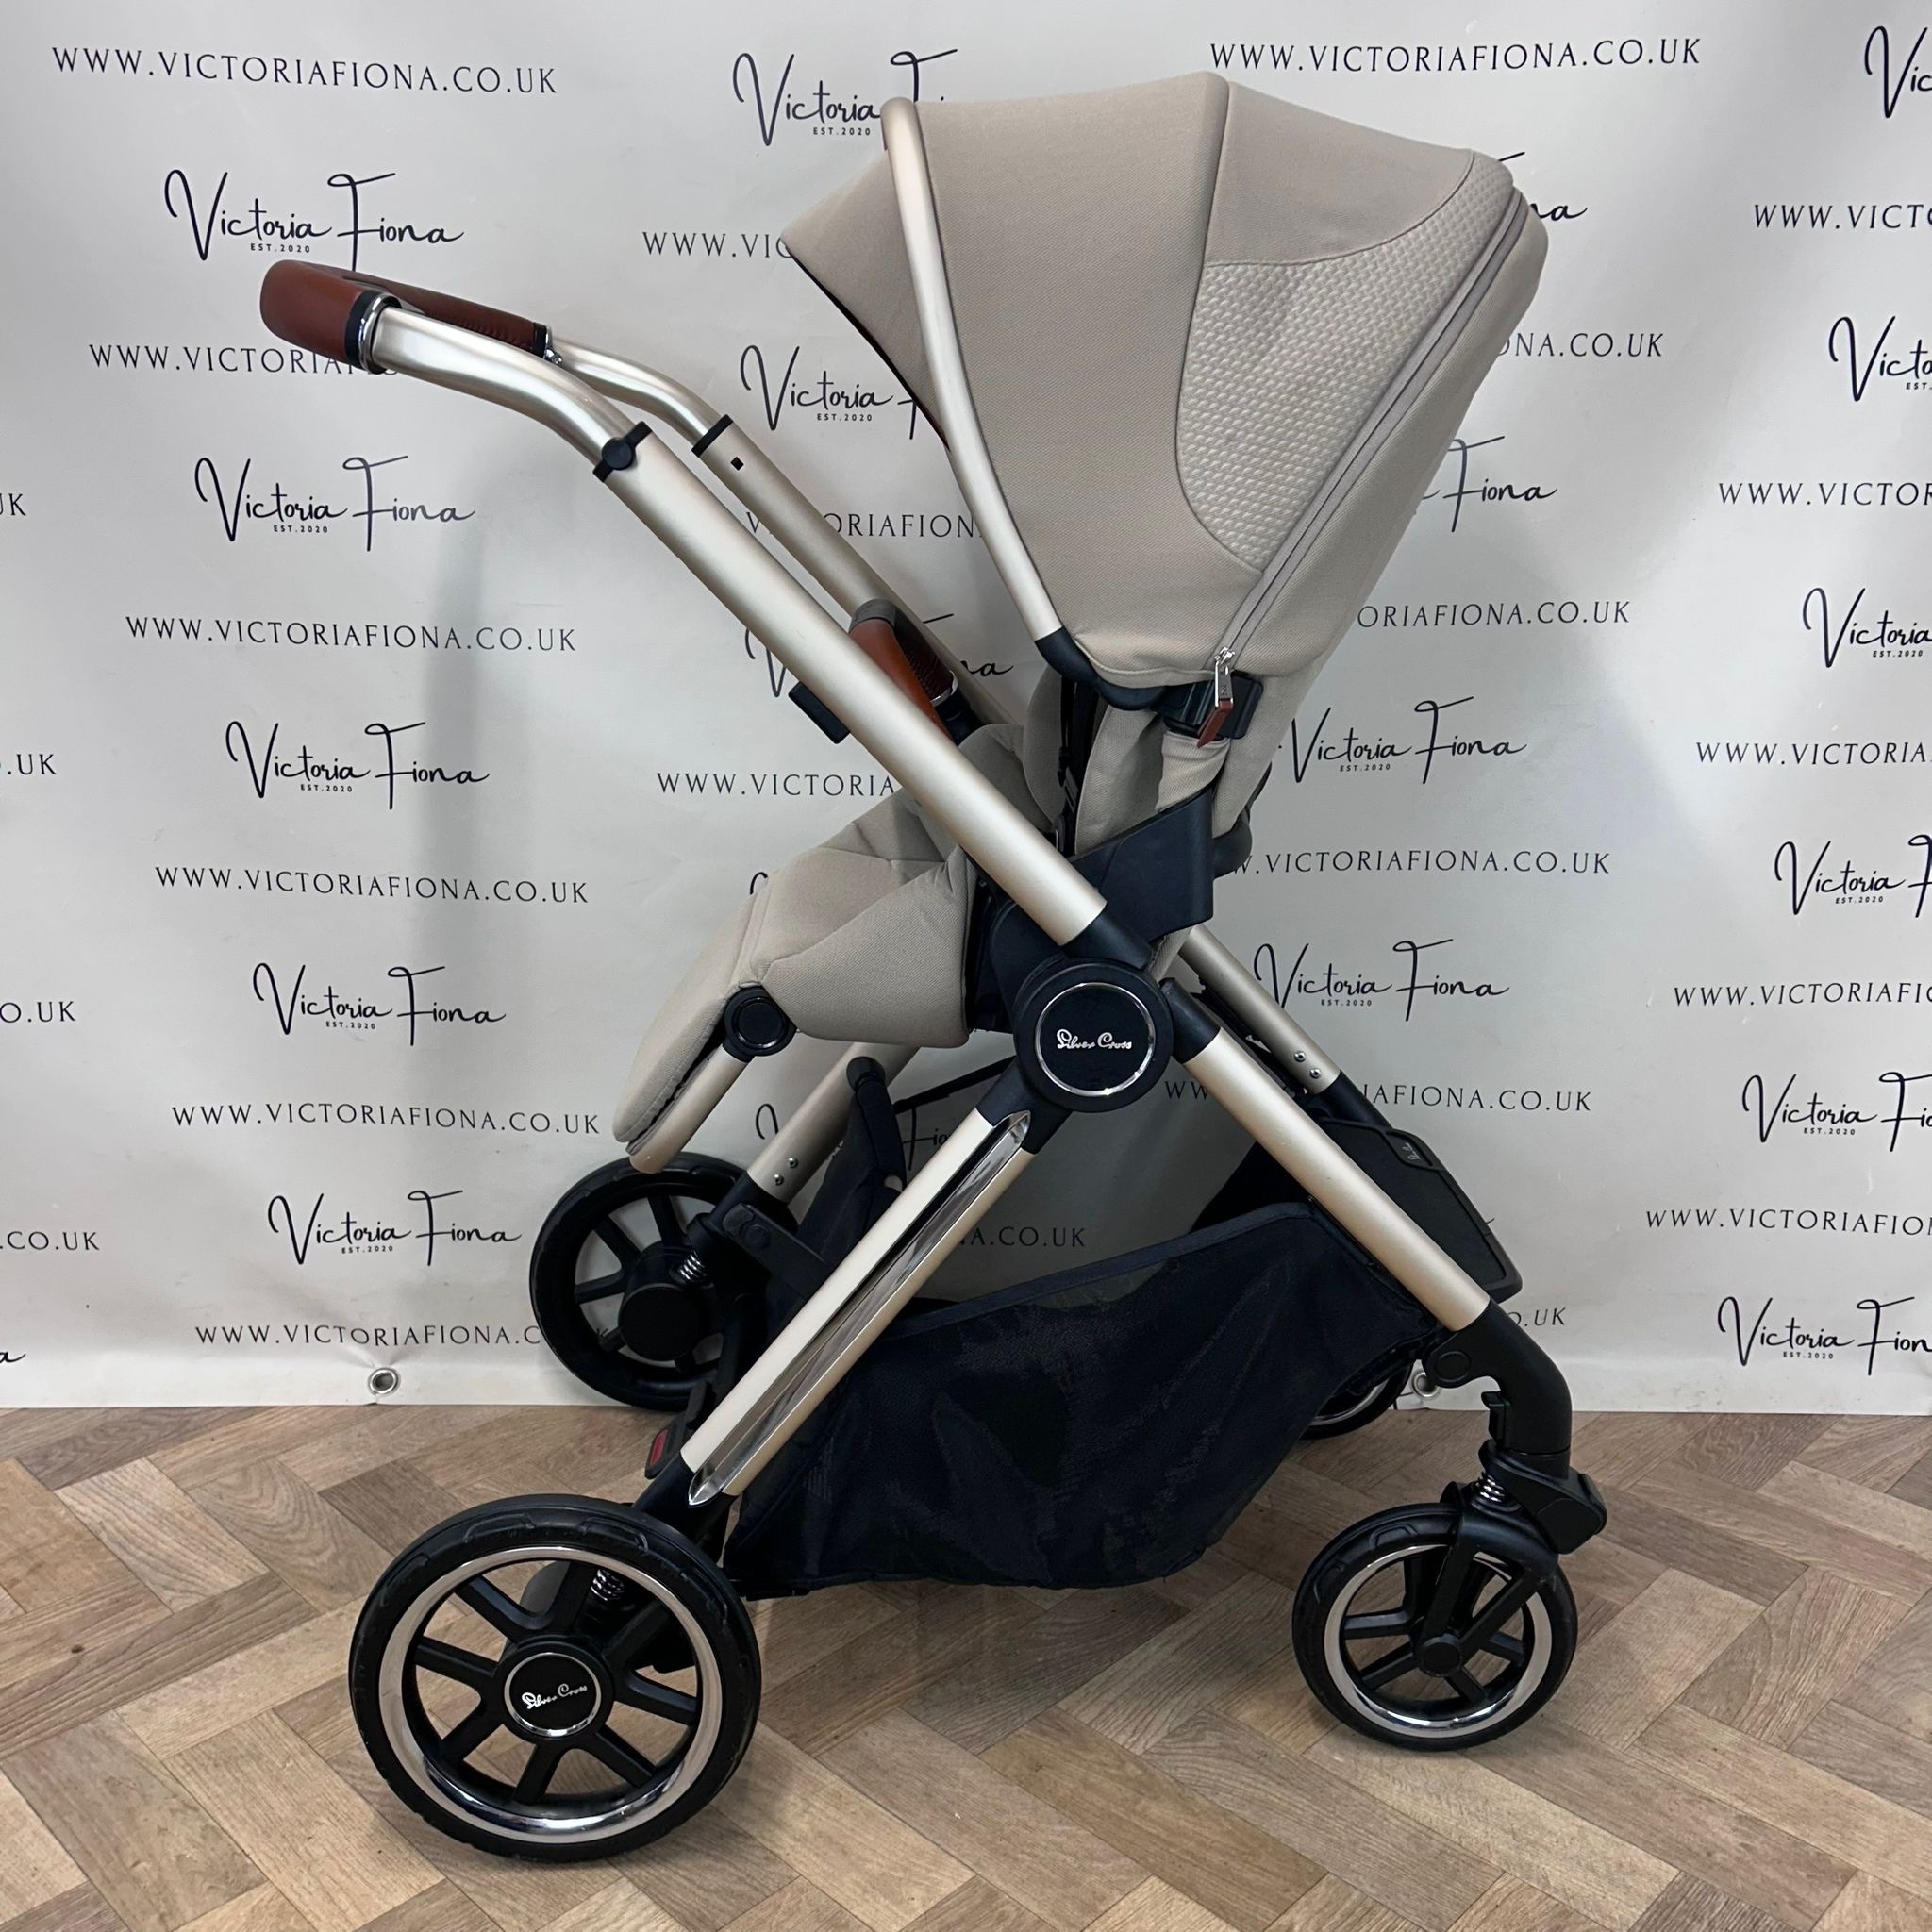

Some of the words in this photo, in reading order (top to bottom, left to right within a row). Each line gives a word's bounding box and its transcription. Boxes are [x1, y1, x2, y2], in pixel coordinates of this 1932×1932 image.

[51, 46, 557, 94] WWW.VICTORIAFIONA.CO.UK
[1209, 38, 1701, 73] WWW.VICTORIAFIONA.CO.UK
[732, 52, 881, 147] Victoria
[812, 126, 871, 136] EST.2020
[163, 169, 333, 263] Victoria
[326, 172, 465, 273] Fiona
[250, 242, 310, 254] EST.2020
[740, 344, 894, 432] Victoria
[816, 412, 873, 422] EST.2020
[1442, 435, 1558, 533] Fiona
[193, 457, 348, 542] Victoria
[341, 455, 476, 553] Fiona
[273, 525, 328, 534] EST.2020
[1357, 601, 1630, 628] ORIAFIONA.CO.UK
[1802, 587, 1932, 669] Victoria
[125, 616, 576, 652] WWW.VICTORIAFIONA.CO.UK
[1872, 649, 1924, 658] EST.2020
[1277, 707, 1413, 784] Victoria
[1413, 695, 1527, 785] Fiona
[1696, 741, 1932, 765] WWW.VICTORIA
[225, 720, 372, 799] Victoria
[363, 721, 491, 811] Fiona
[1339, 763, 1391, 773] EST.2020
[300, 783, 353, 793] EST.2020
[155, 866, 588, 904] WWW.VICTORIAFIONA.CO.UK
[1774, 840, 1907, 916] Victoria
[1835, 895, 1884, 905] EST.2020
[1253, 942, 1393, 1009] Victoria
[1391, 938, 1510, 1023] Fiona
[252, 962, 393, 1036] Victoria
[387, 965, 507, 1047] Fiona
[1321, 998, 1373, 1007] EST.2020
[325, 1020, 376, 1030] EST.2020
[1056, 1028, 1095, 1049] Silver
[1097, 1031, 1132, 1049] Cross
[172, 1102, 600, 1134] WWW.VICTORIAFIONA.CO.UK
[1741, 1073, 1878, 1143] Victoria
[1803, 1127, 1856, 1136] EST.2020
[267, 1192, 412, 1266] Victoria
[407, 1190, 523, 1267] Fiona
[959, 1225, 1086, 1248] A.CO.UK
[341, 1244, 393, 1255] EST.2020
[1717, 1295, 1856, 1367] Victoria
[1782, 1351, 1834, 1359] EST.2020
[521, 1691, 558, 1710] Silver
[557, 1683, 588, 1697] Cross
